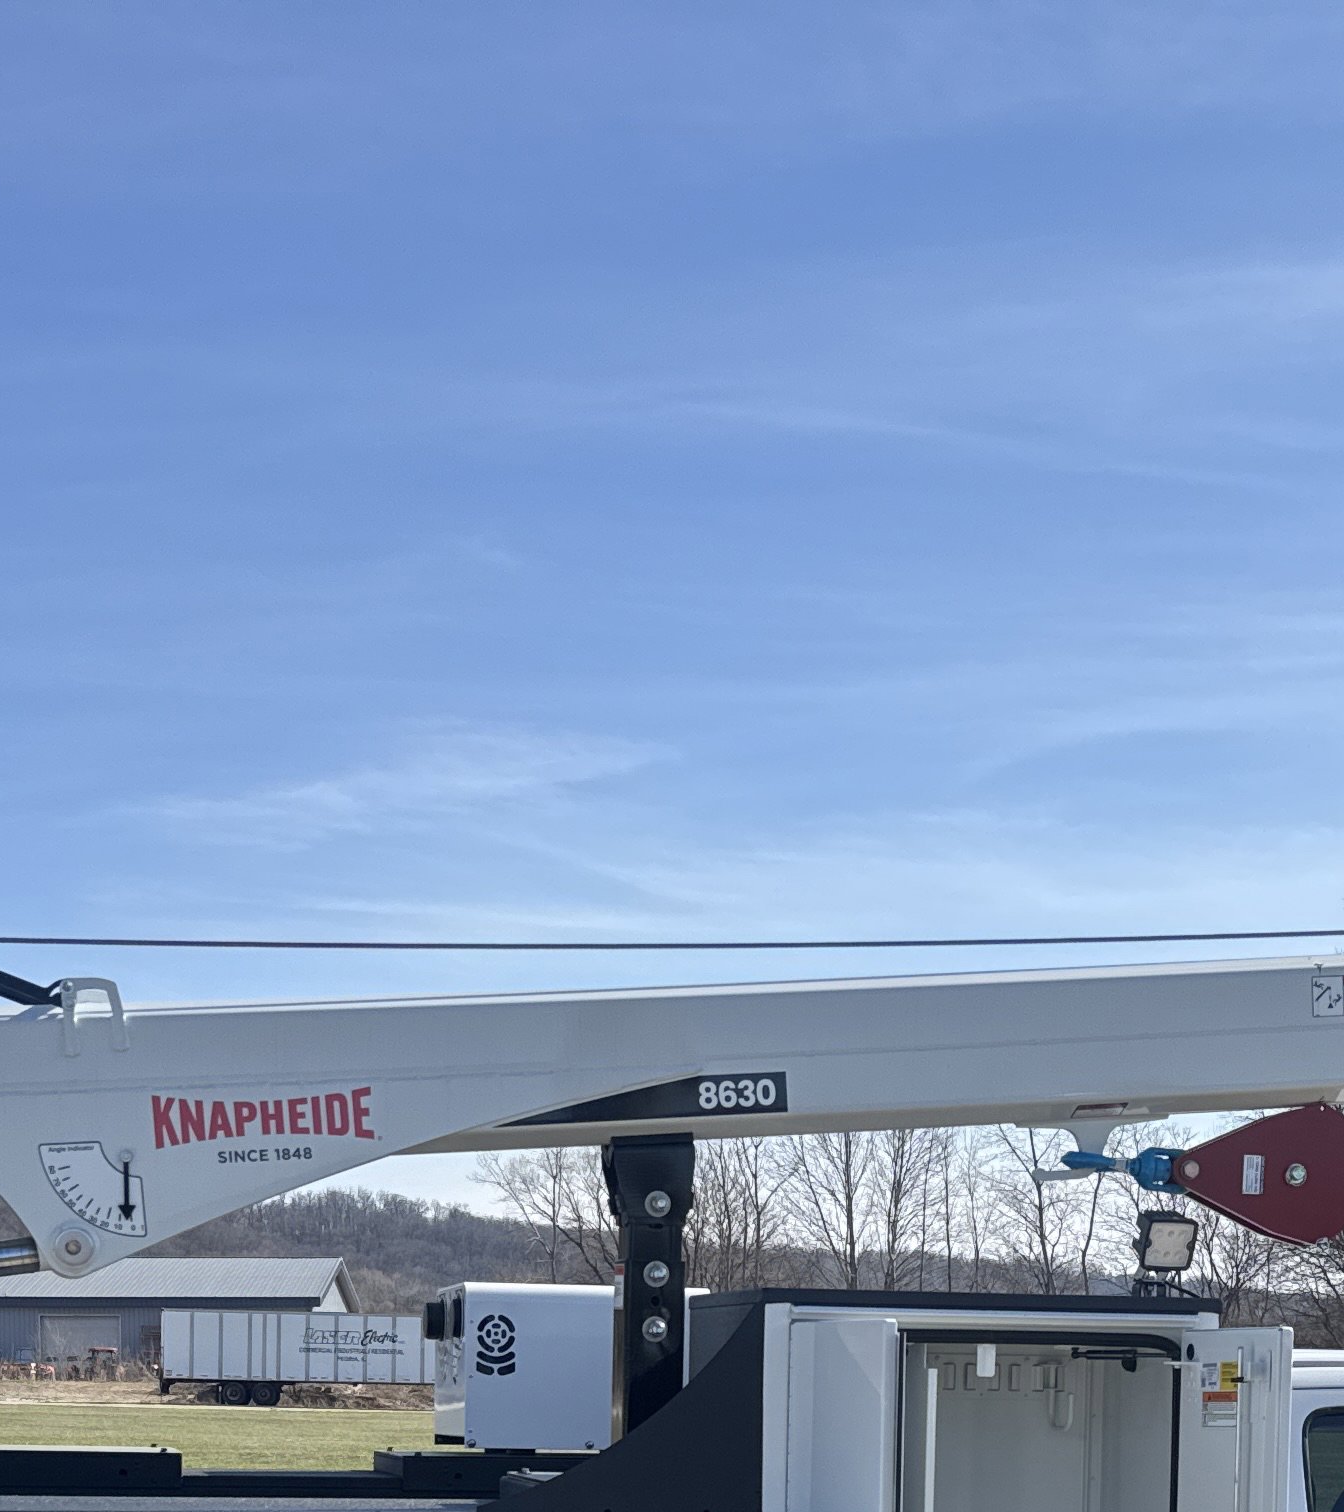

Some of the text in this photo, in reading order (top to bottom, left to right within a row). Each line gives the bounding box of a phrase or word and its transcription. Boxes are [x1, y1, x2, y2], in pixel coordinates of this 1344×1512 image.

[699, 1078, 776, 1109] 8630
[151, 1086, 375, 1149] KNAPHEIDE
[218, 1147, 313, 1164] SINCE 1848
[303, 1328, 399, 1346] LASER Electric
